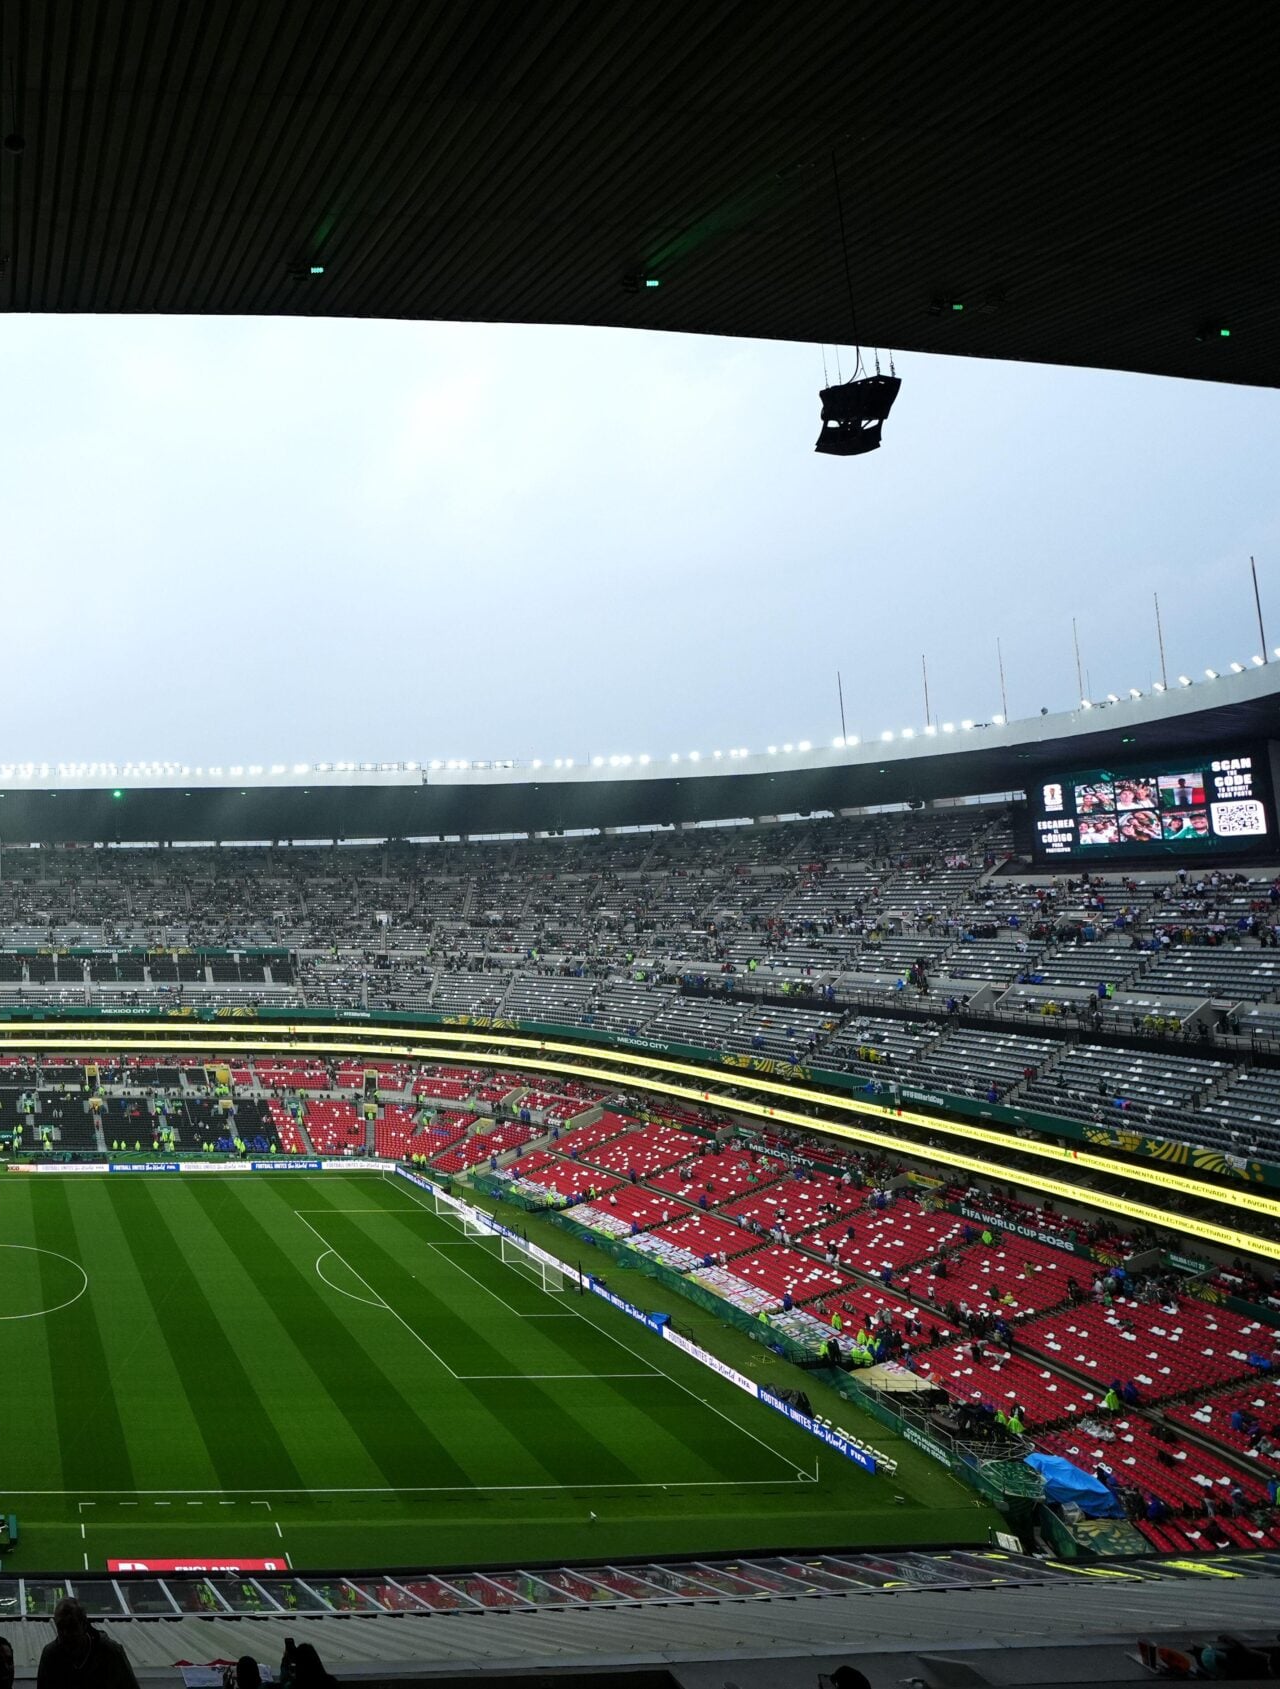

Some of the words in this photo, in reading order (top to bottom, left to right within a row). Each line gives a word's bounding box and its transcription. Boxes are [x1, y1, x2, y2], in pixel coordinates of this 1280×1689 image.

[1211, 758, 1251, 772] SCAN
[1214, 774, 1252, 787] CODE
[1037, 819, 1074, 830] ESCANEA
[1042, 833, 1072, 843] CÓDIGO
[617, 1037, 648, 1046] MEXICO
[902, 1090, 944, 1105] #FIFAWorldCup
[749, 1143, 790, 1160] MEXICO
[790, 1155, 814, 1167] CITY
[1121, 1167, 1154, 1180] TORMENTA
[1192, 1186, 1227, 1198] ACTIVADO
[1243, 1198, 1267, 1209] FAVOR
[962, 1208, 981, 1220] FIFA
[982, 1214, 1016, 1231] WORLD
[1017, 1226, 1036, 1238] CUP
[1038, 1233, 1074, 1251] 2026
[1124, 1205, 1160, 1218] TORMENTA
[1196, 1226, 1232, 1240] ACTIVADO
[1247, 1241, 1272, 1252] FAVOR
[593, 1283, 610, 1301] FOOTBALL
[611, 1294, 624, 1310] UNITES
[668, 1331, 690, 1352] FOOTBALL
[690, 1346, 707, 1363] UNITES
[709, 1358, 717, 1369] the
[718, 1363, 735, 1380] World
[738, 1377, 751, 1389] FIFA
[760, 1389, 789, 1415] FOOTBALL
[790, 1408, 811, 1429] UNITES
[812, 1423, 825, 1438] the
[825, 1431, 847, 1455] World
[850, 1449, 867, 1465] FIFA
[904, 1431, 910, 1440] DE
[911, 1436, 918, 1445] LA
[918, 1441, 931, 1455] FIFA
[931, 1450, 951, 1467] 2026
[907, 1428, 921, 1440] COPA
[922, 1437, 946, 1458] MUNDIAL
